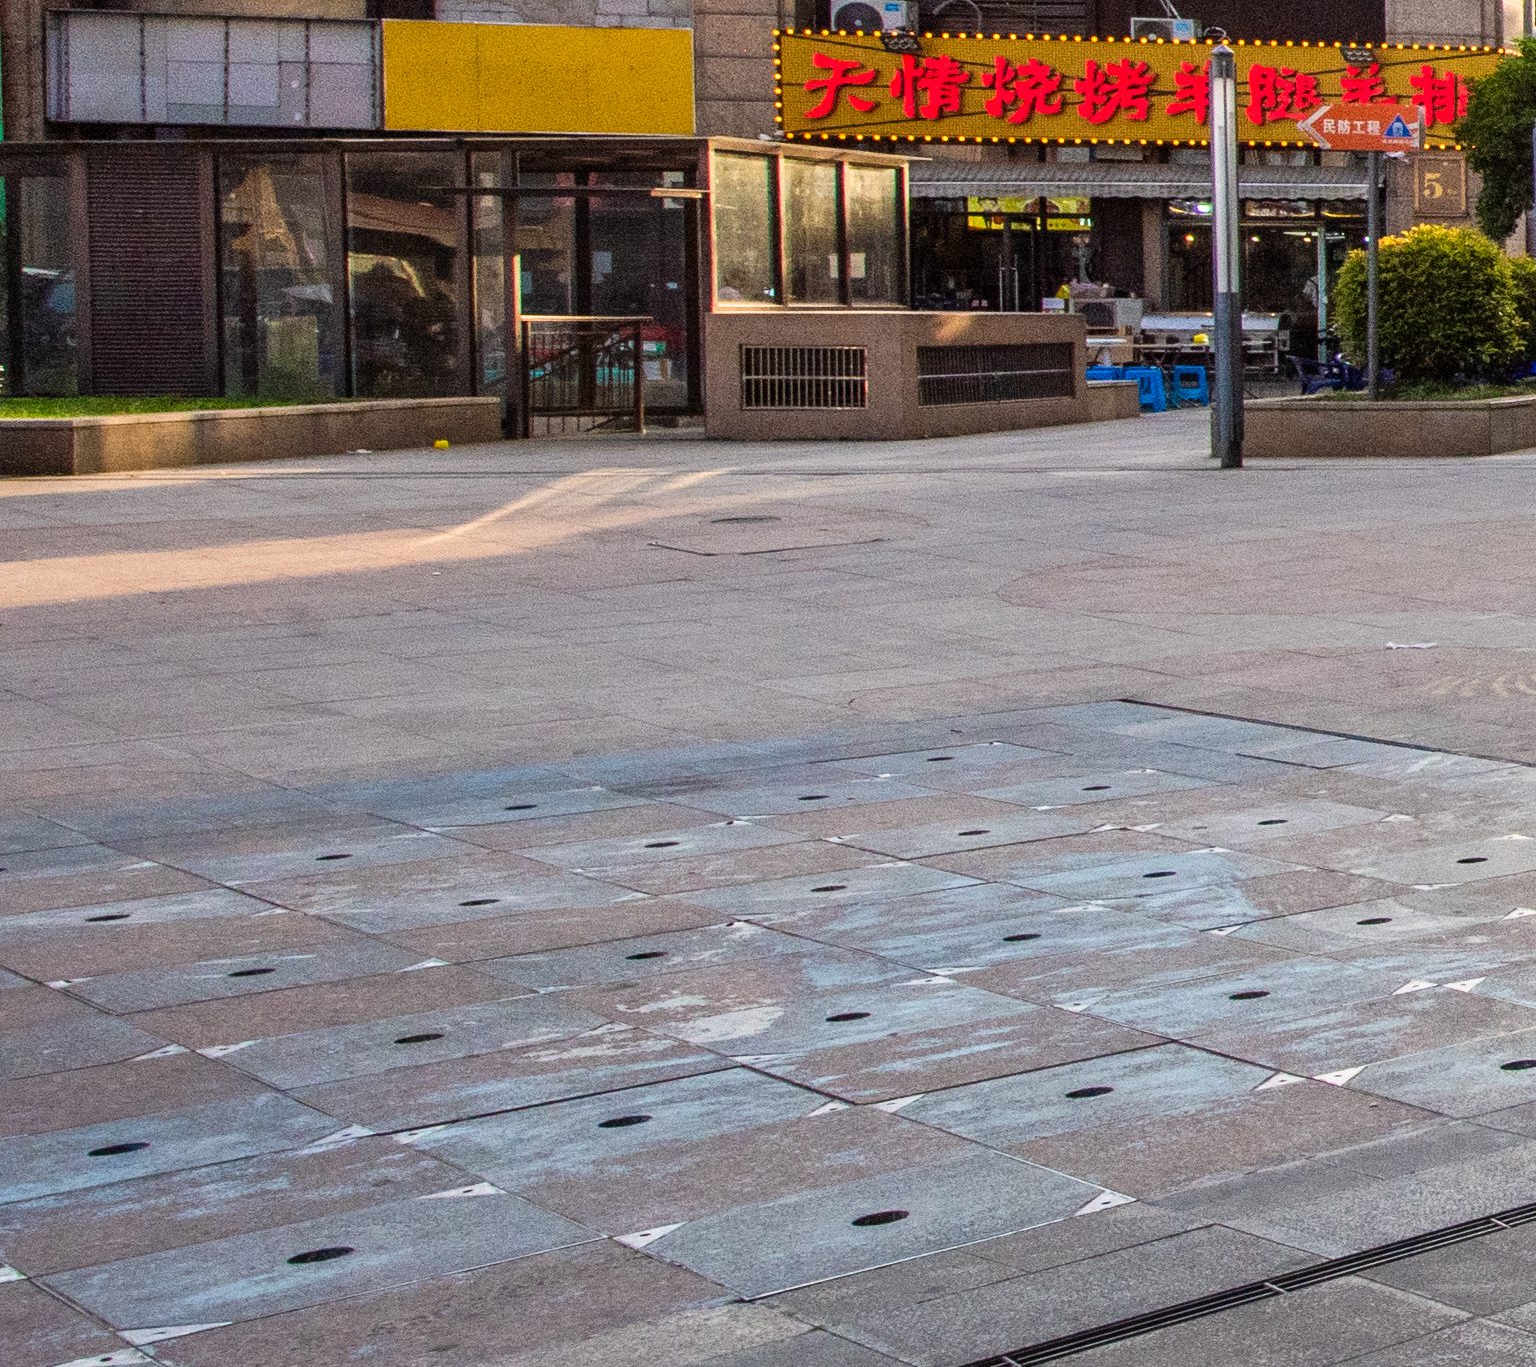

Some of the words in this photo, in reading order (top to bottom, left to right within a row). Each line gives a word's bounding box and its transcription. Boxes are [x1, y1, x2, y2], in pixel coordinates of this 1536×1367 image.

[1322, 118, 1381, 136] 民防工程
[1422, 172, 1443, 199] 5
